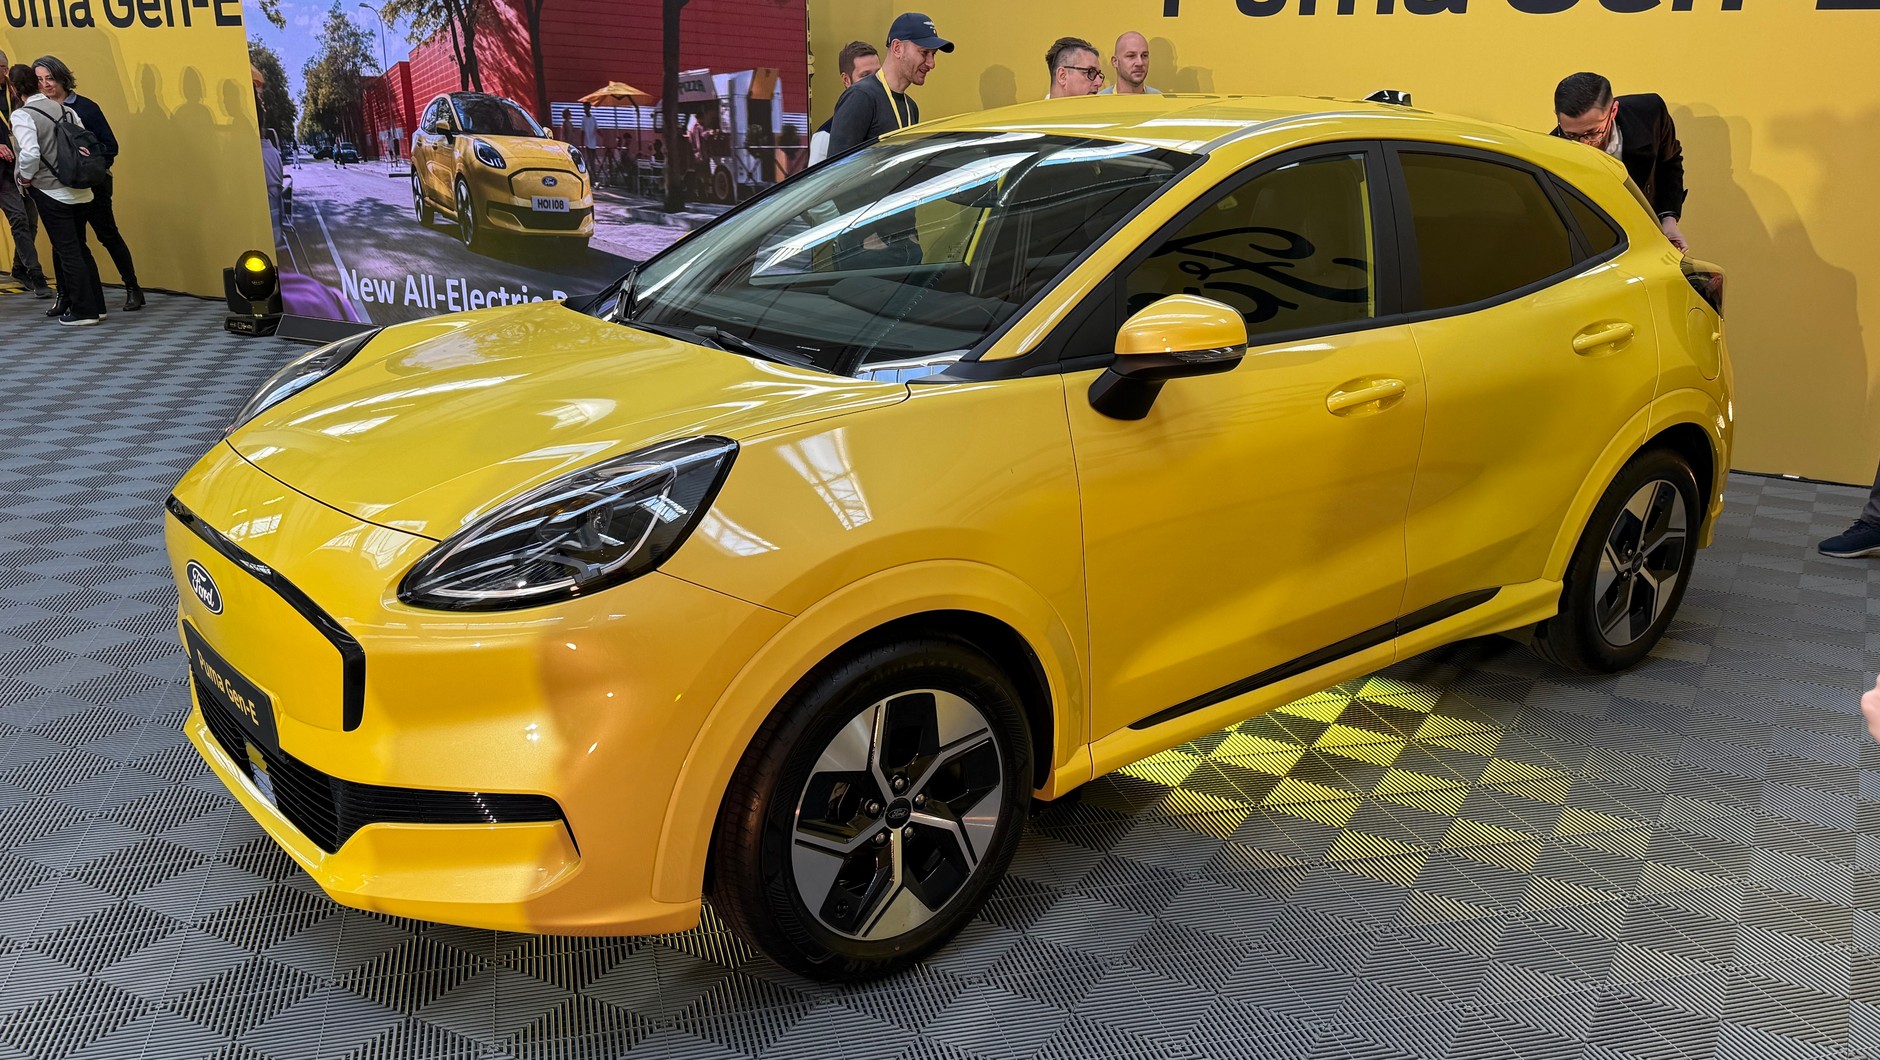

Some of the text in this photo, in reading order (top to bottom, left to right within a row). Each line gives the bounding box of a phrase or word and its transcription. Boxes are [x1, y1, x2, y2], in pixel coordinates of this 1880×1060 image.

[3, 0, 95, 28] uma
[341, 269, 543, 312] New All-Electri
[192, 567, 215, 607] Ford
[196, 648, 260, 726] Puma Gen-E
